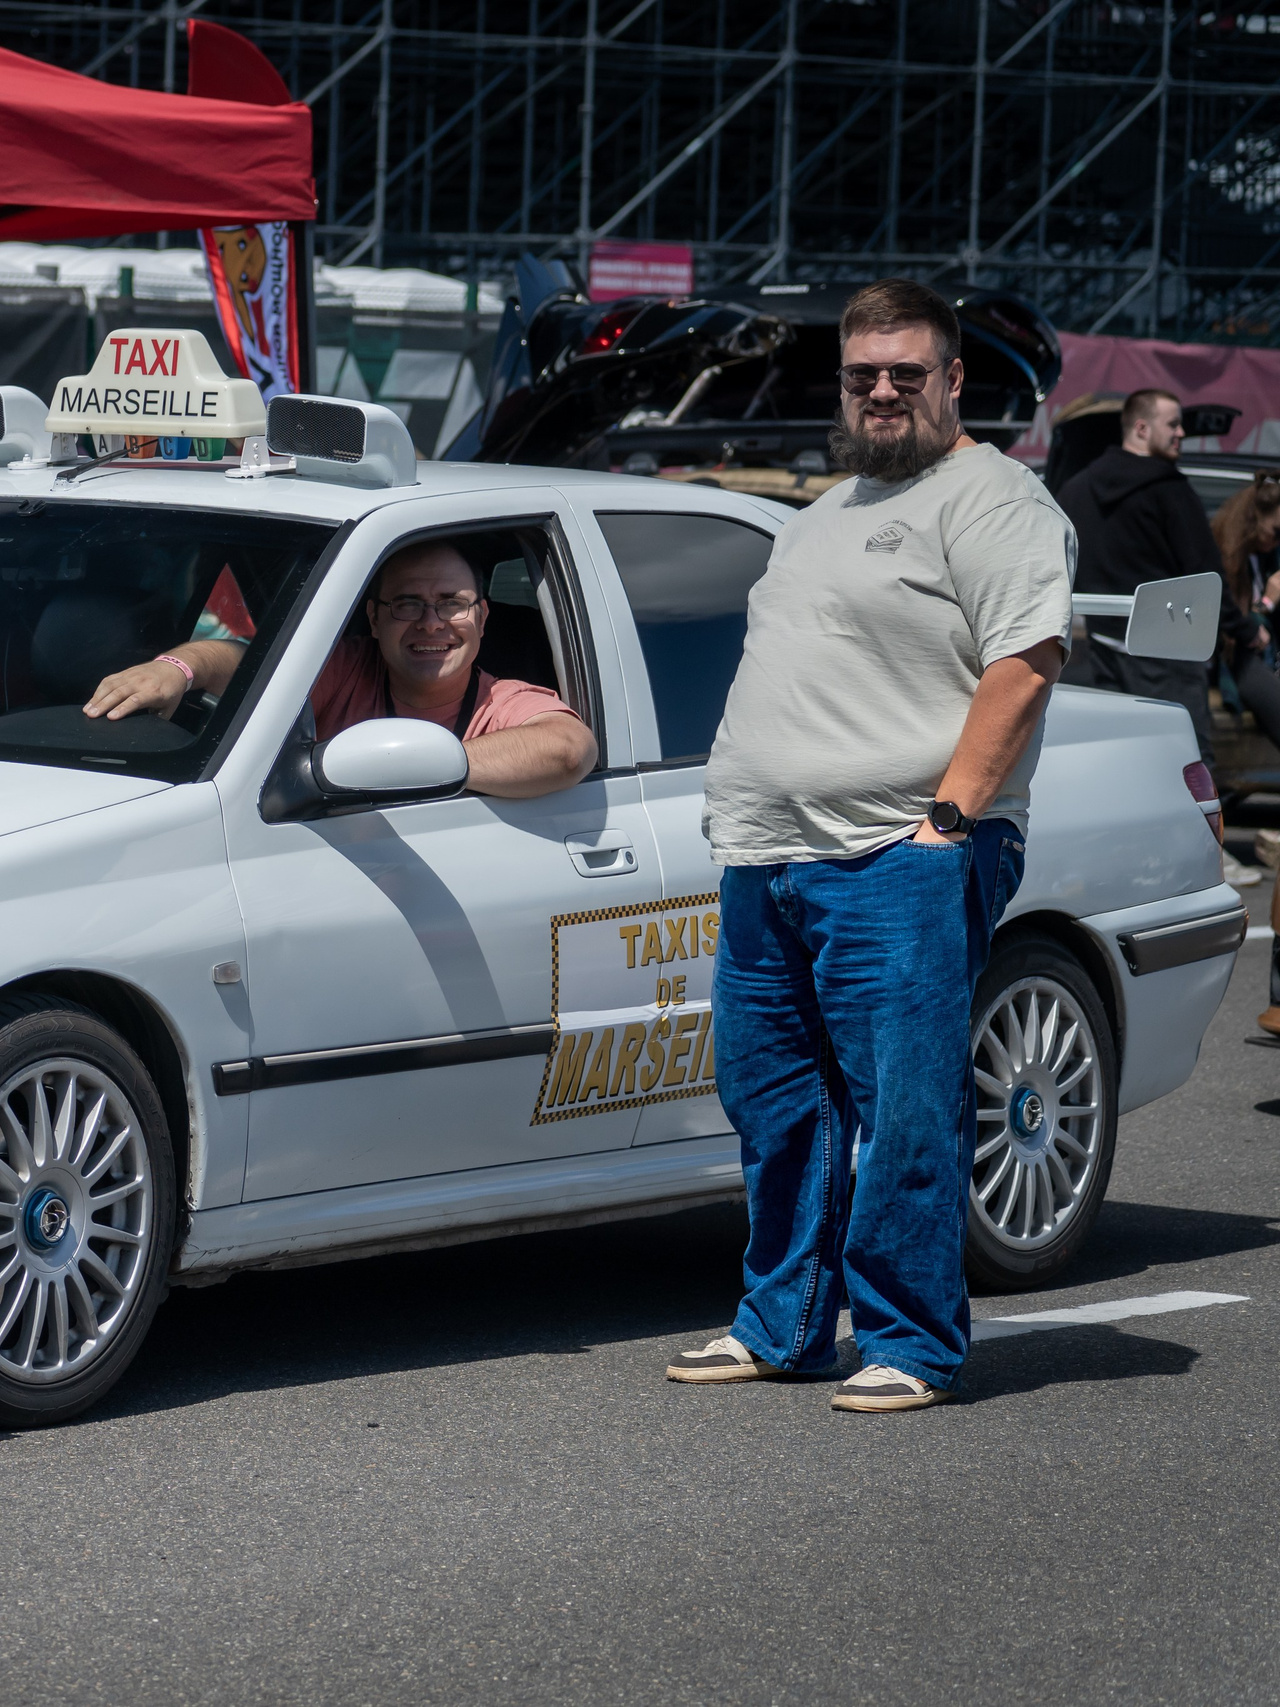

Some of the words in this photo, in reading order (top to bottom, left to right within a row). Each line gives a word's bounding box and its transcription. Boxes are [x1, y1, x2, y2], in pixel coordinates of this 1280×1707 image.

[110, 338, 180, 376] TAXI
[60, 387, 219, 418] MARSEILLE
[619, 911, 720, 969] TAXIS
[656, 974, 687, 1009] DE
